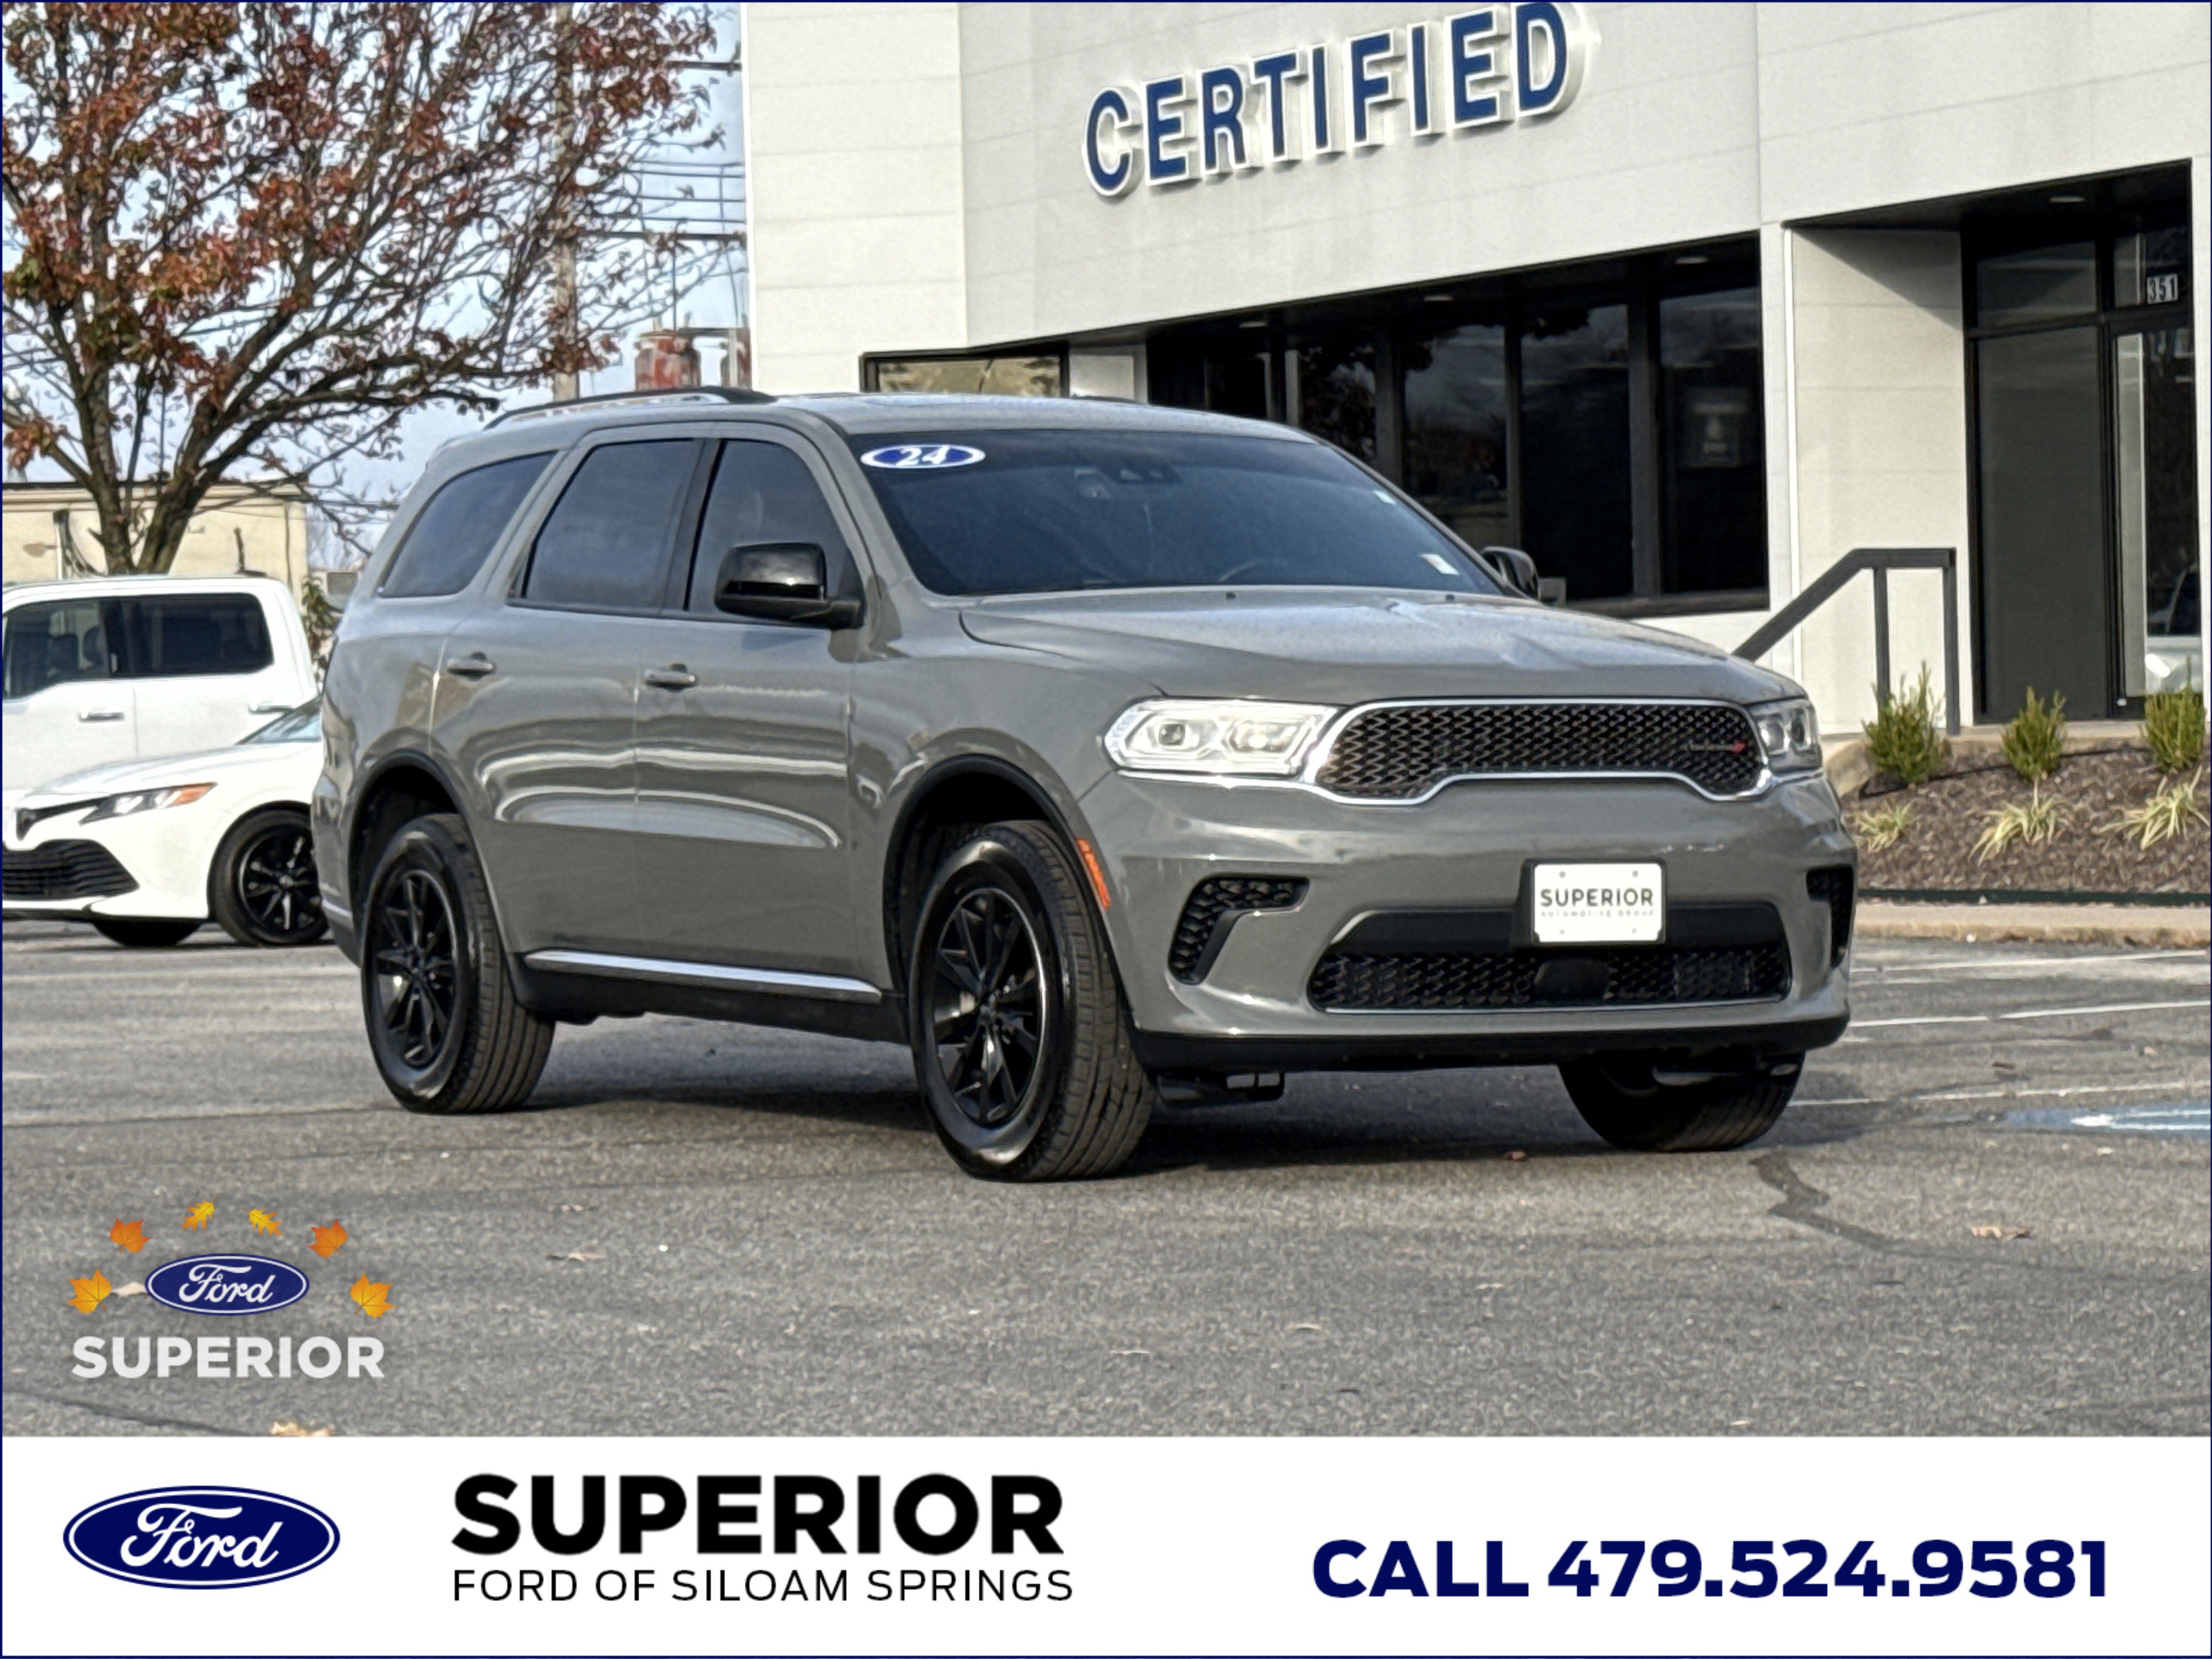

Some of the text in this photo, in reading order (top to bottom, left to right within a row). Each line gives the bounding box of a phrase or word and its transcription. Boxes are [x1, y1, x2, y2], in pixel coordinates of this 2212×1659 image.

[1084, 2, 1570, 196] CERTIFIED
[2149, 276, 2175, 302] 351
[895, 445, 950, 467] 24
[1540, 887, 1654, 907] SUPERIOR
